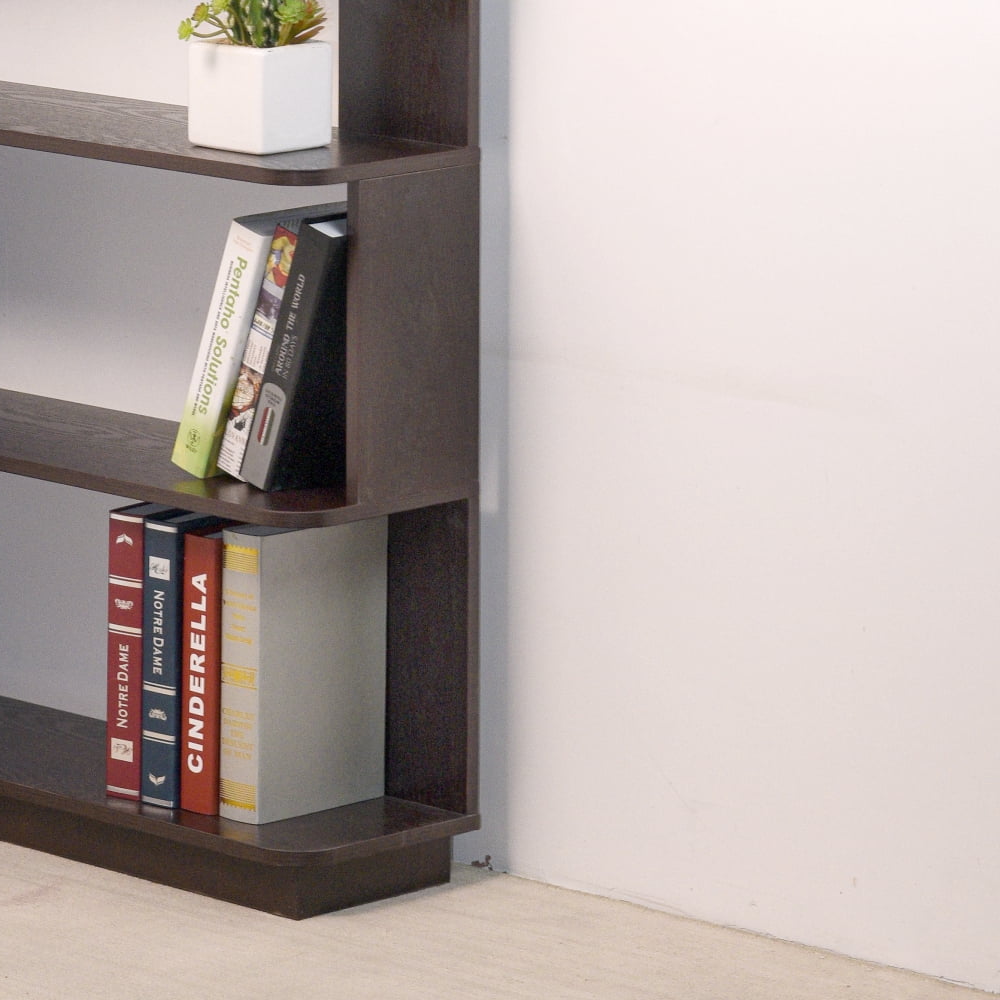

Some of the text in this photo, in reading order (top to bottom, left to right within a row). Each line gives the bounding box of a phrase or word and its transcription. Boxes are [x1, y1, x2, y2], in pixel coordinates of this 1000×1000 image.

[221, 256, 248, 329] Pentaho
[274, 273, 306, 375] AROUND THE WORLD
[199, 336, 227, 416] Solutions
[152, 590, 165, 676] NOTRE DAME
[188, 573, 208, 774] CINDERELLA
[116, 643, 130, 728] NOTRE DAME
